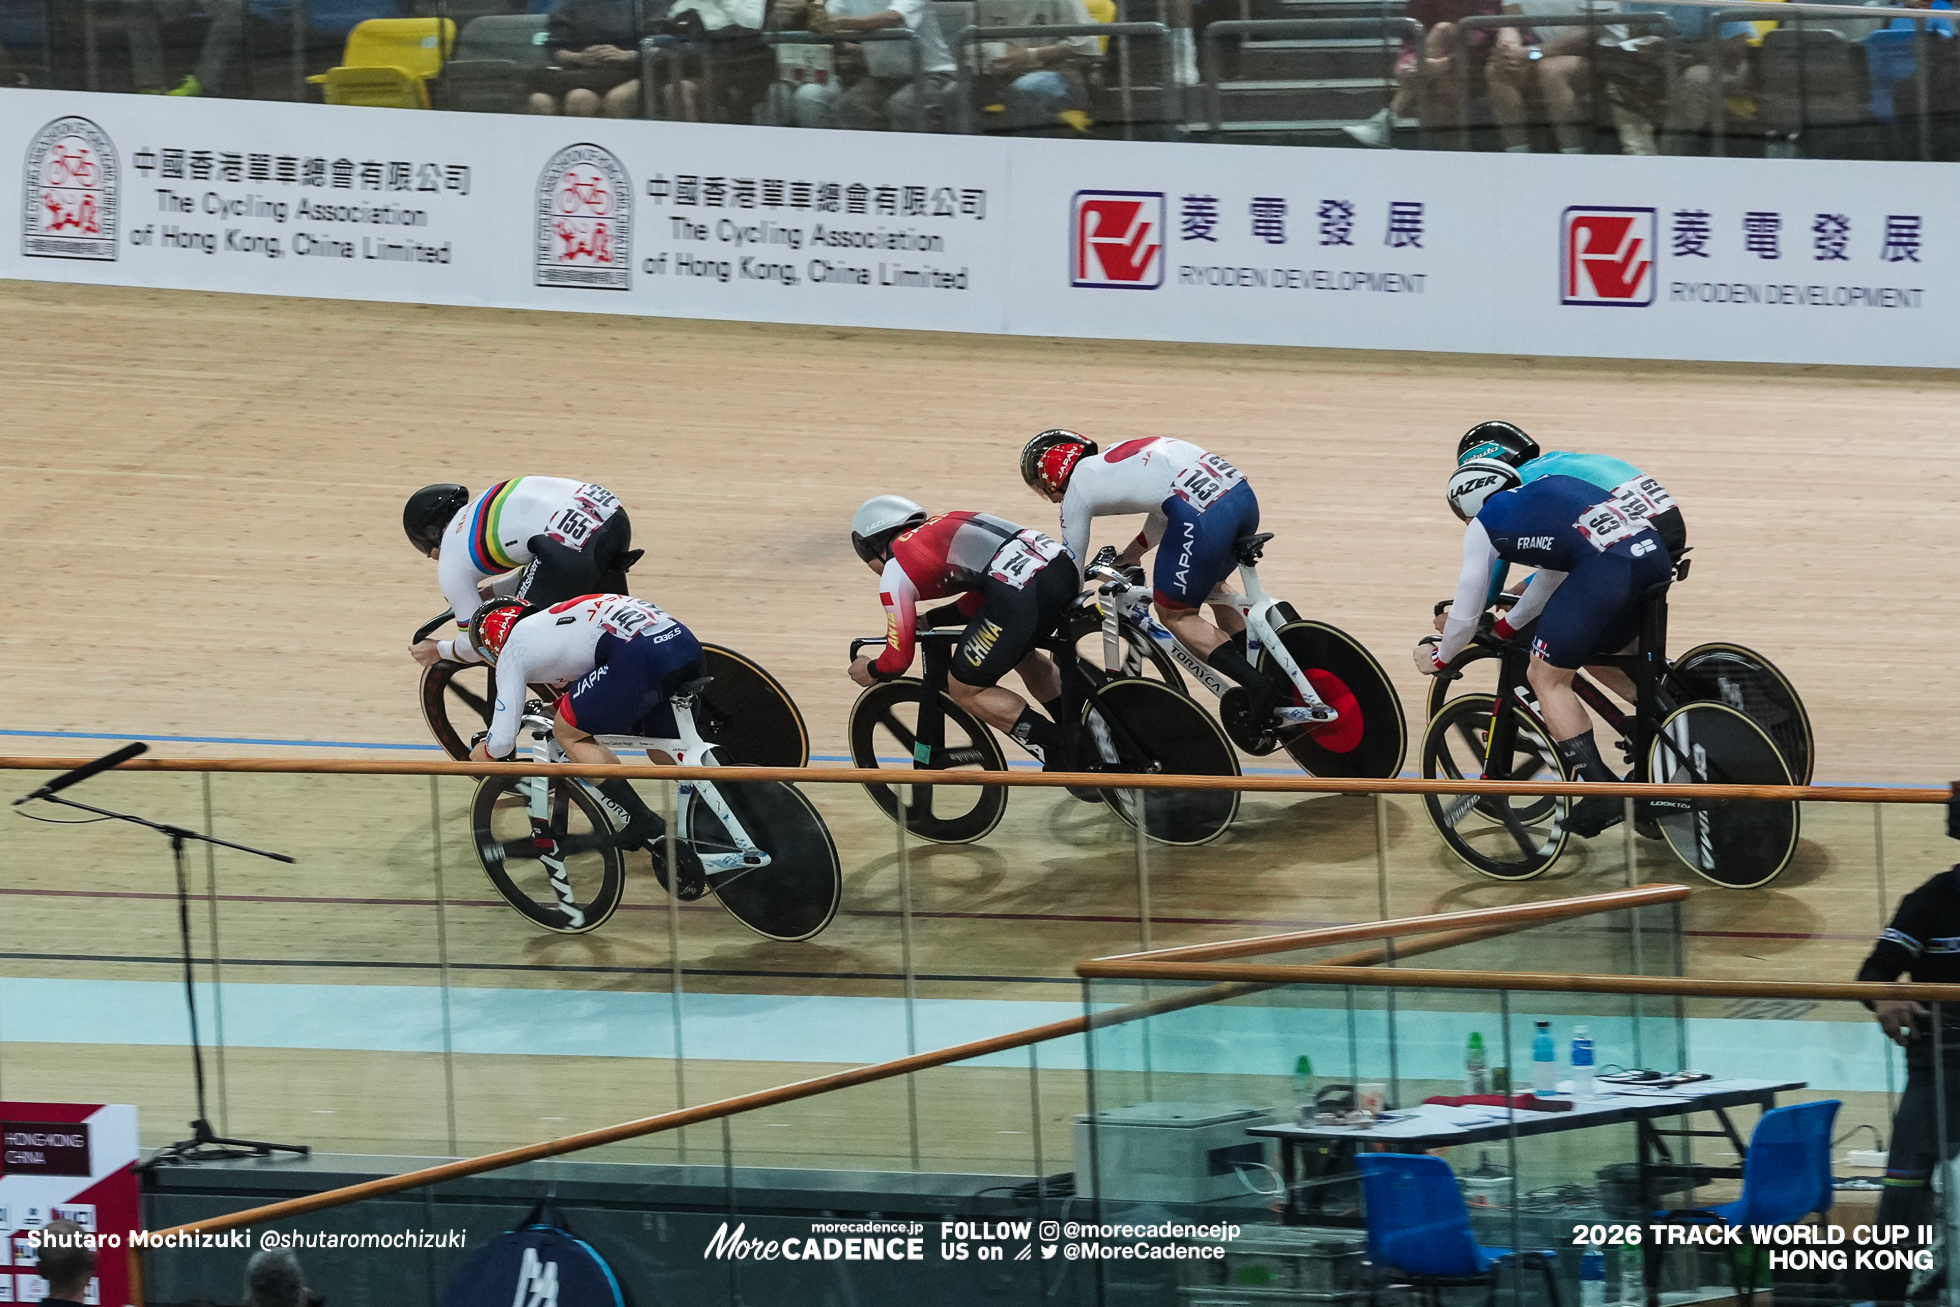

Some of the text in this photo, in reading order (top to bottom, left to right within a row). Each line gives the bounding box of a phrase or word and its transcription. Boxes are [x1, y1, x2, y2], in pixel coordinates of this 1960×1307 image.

[133, 147, 472, 196] 中國香港單車總會有限公司
[155, 188, 429, 227] The Cycling Association
[646, 172, 988, 220] 中國香港單車總會有限公司
[670, 216, 945, 252] The Cycling Association
[1178, 194, 1425, 249] 菱電發展
[1670, 208, 1922, 264] 菱電發展
[129, 225, 452, 264] of Hong Kong, China Limited
[642, 253, 969, 291] of Hong Kong, China Limited
[1178, 265, 1428, 294] RYODEN DEVELOPMENT
[1669, 281, 1925, 309] RYODEN DEVELOPMENT
[1057, 446, 1078, 479] JAPAN
[1183, 469, 1220, 501] 143
[1450, 475, 1499, 500] LAZER
[557, 508, 593, 540] 155
[1589, 512, 1621, 536] 93
[1173, 522, 1194, 595] JAPAN
[1517, 536, 1555, 551] FRANCE
[1002, 551, 1031, 577] 74
[497, 608, 516, 643] JAPAN
[610, 606, 647, 632] 142
[887, 613, 901, 651] ANTA
[963, 617, 1003, 667] CHINA
[572, 664, 609, 699] JAPAN
[1169, 645, 1220, 694] TORAYCA
[600, 794, 630, 823] TORA
[4, 1132, 47, 1147] HONG
[4, 1150, 46, 1165] CHINA
